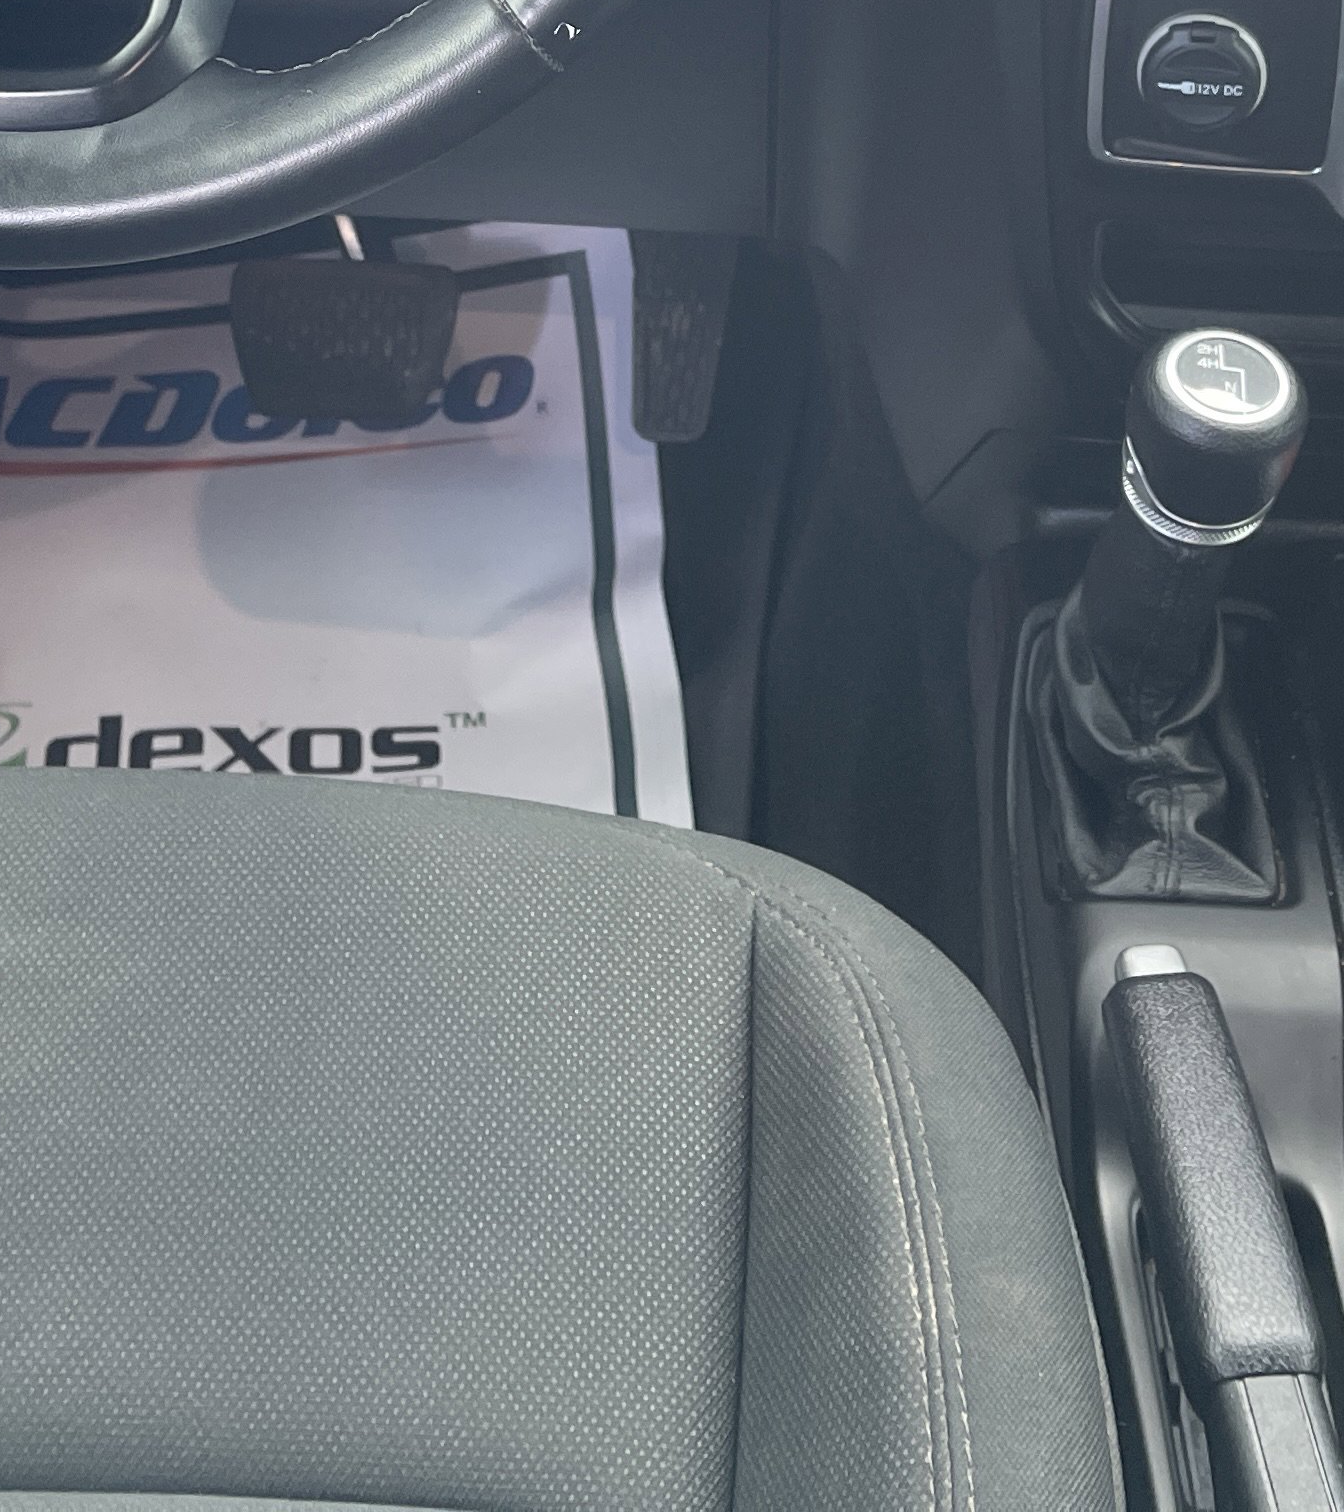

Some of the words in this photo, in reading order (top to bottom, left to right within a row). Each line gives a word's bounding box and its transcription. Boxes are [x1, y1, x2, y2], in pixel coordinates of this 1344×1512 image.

[1198, 83, 1221, 96] 12V
[1223, 85, 1244, 98] DC
[45, 715, 441, 776] dexos
